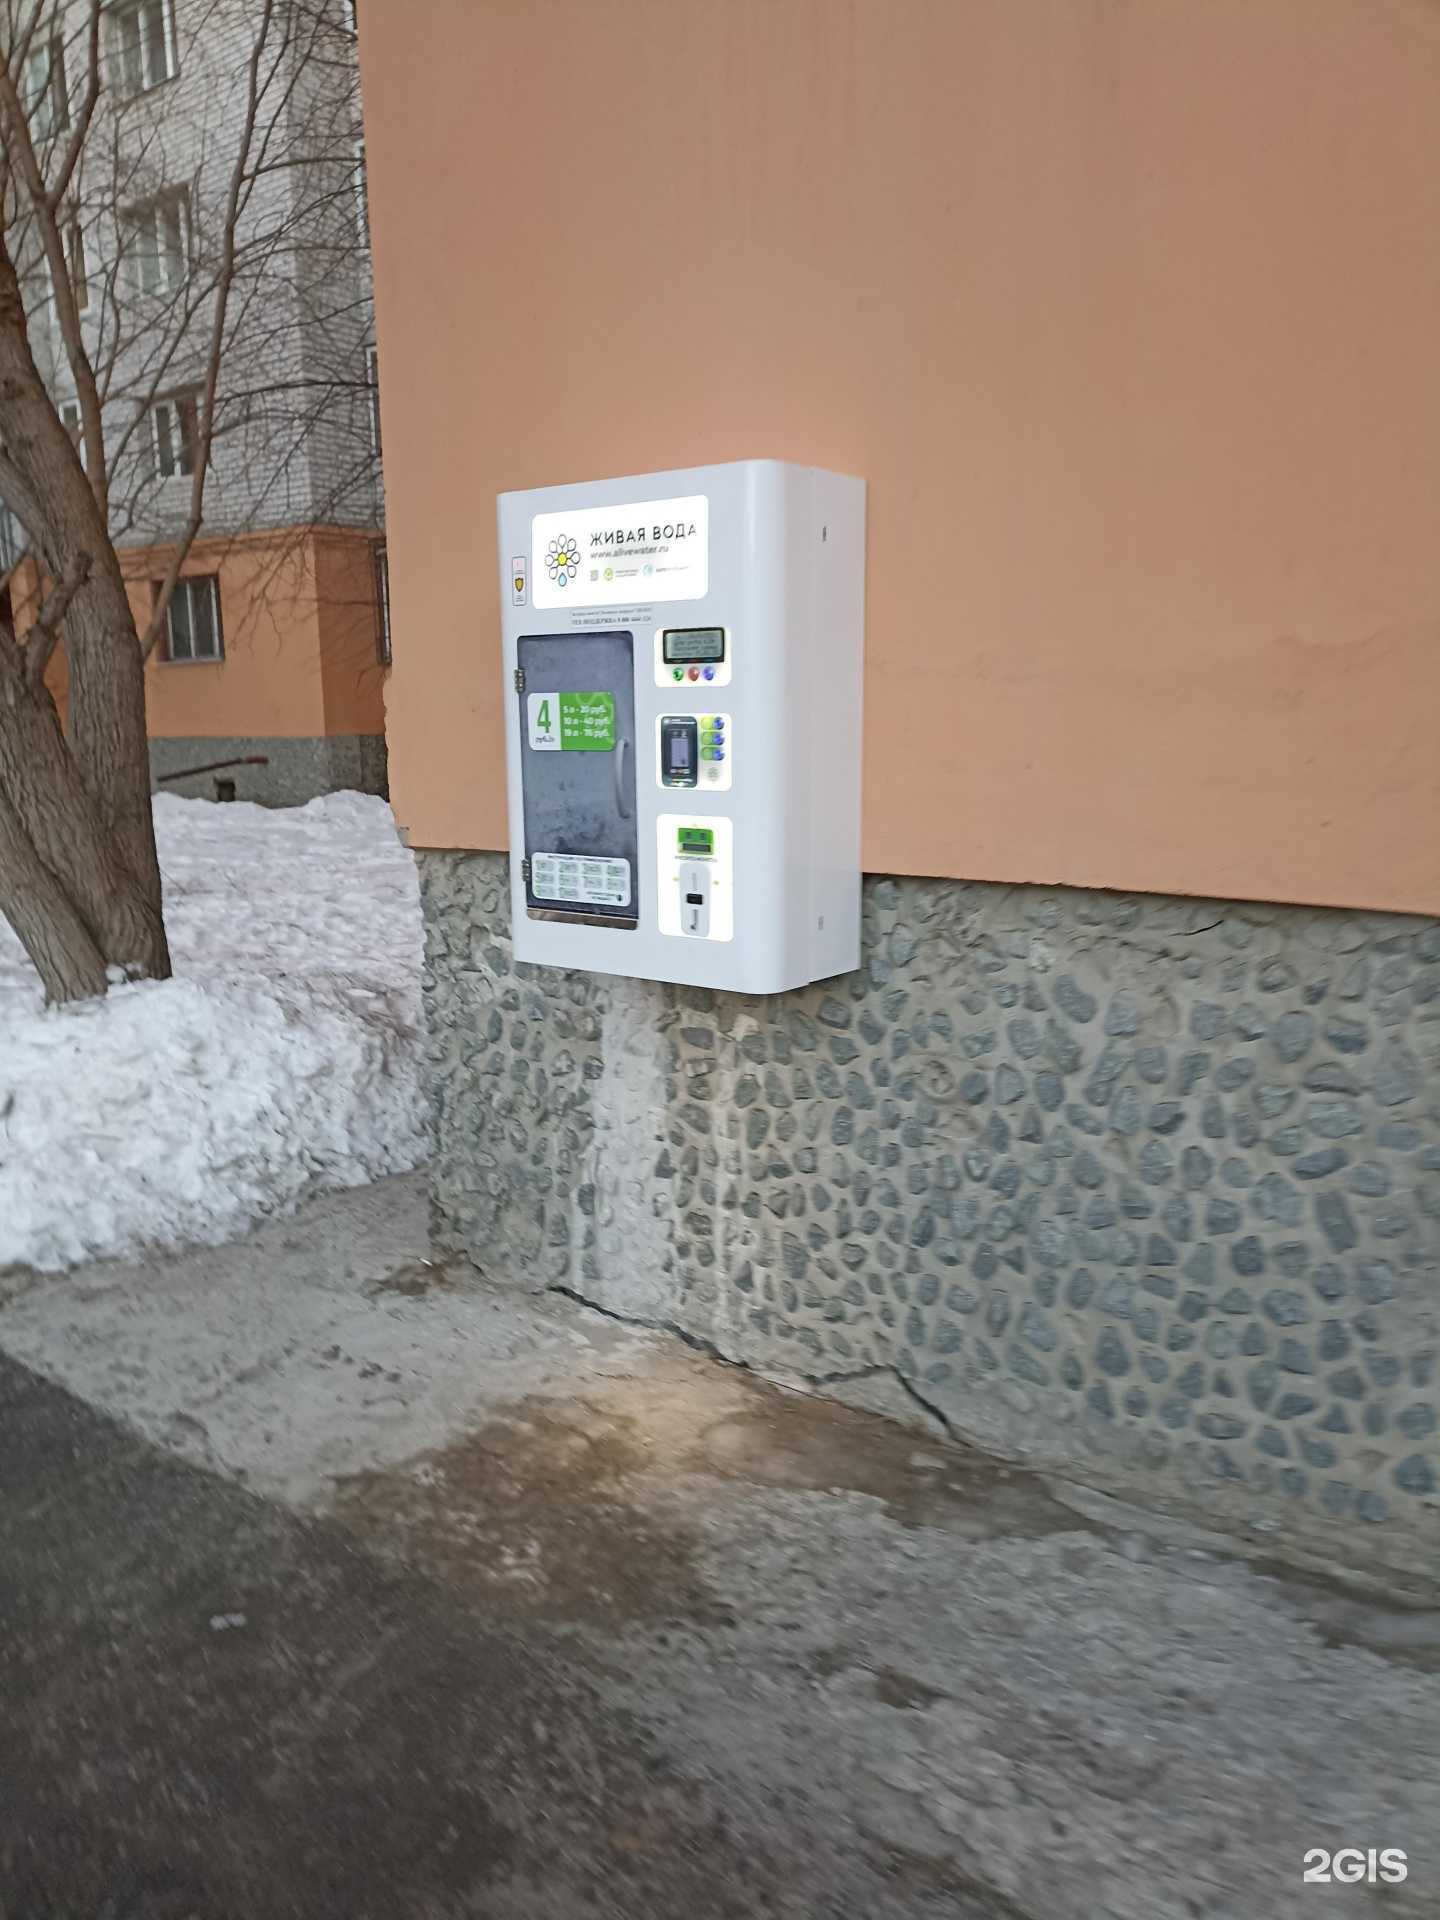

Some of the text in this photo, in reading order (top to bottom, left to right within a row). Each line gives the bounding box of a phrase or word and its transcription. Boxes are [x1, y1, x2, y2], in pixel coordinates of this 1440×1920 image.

[590, 523, 698, 546] ЖИВАЯ ВОДА
[590, 545, 670, 560] www.alivewater.ru
[536, 699, 552, 734] 4
